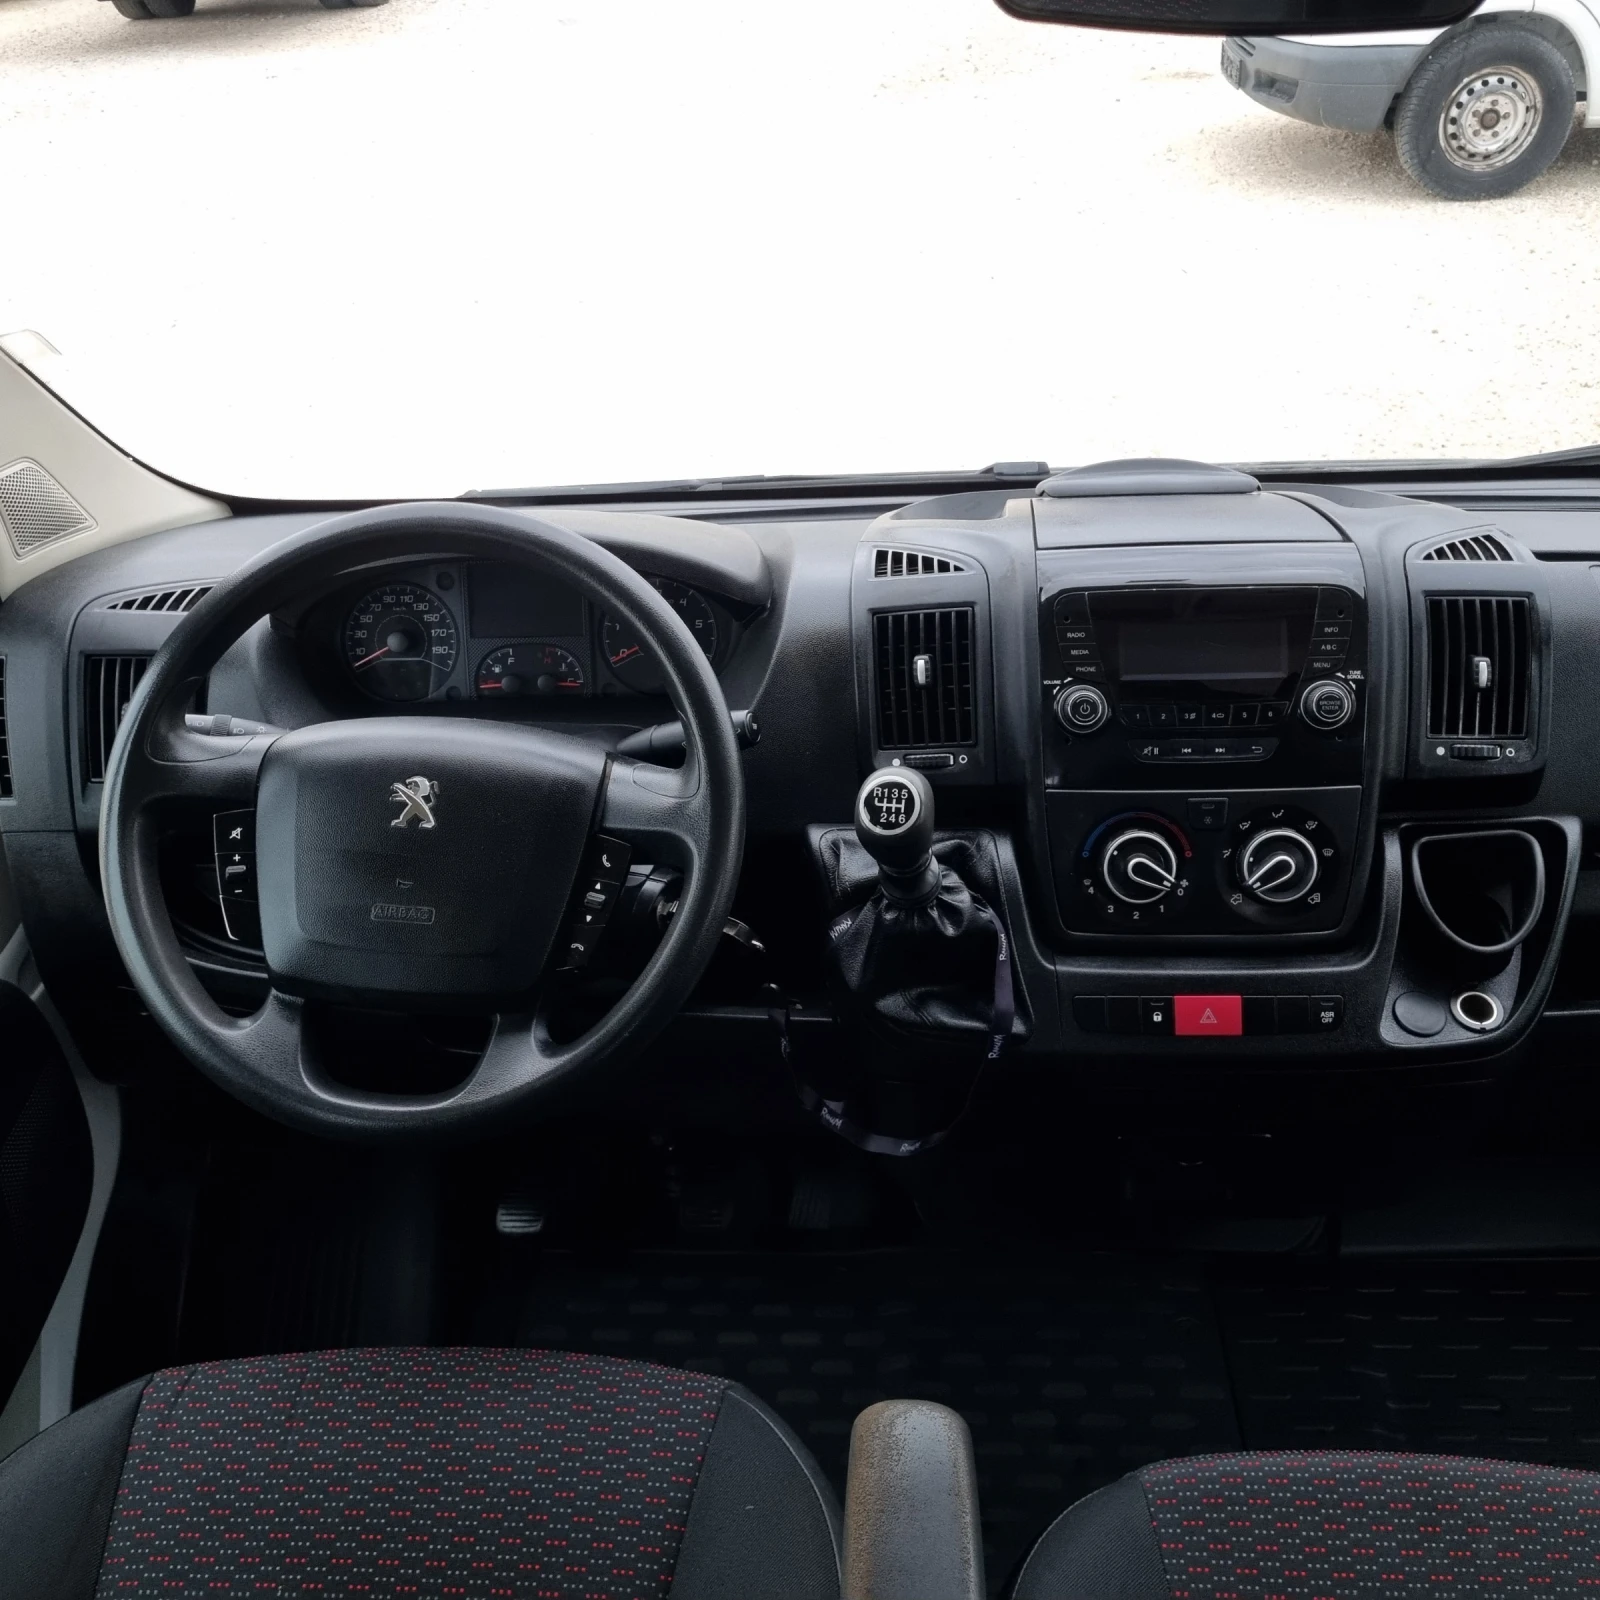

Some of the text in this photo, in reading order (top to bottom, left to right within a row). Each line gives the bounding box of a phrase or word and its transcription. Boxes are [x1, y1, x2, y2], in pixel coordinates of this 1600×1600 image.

[383, 595, 396, 603] 90
[400, 595, 414, 603] 110
[679, 598, 687, 606] 4
[369, 603, 382, 612] 70
[412, 603, 429, 611] 130
[423, 614, 440, 622] 150
[695, 619, 703, 628] 5
[354, 630, 368, 638] 30
[431, 629, 447, 637] 170
[355, 647, 366, 655] 10
[431, 646, 448, 654] 190
[507, 657, 515, 665] F
[873, 787, 908, 799] R 1 3 5
[880, 812, 906, 824] 2 4 6
[1087, 886, 1095, 895] 4
[1177, 888, 1184, 896] 0
[373, 905, 430, 920] AIRBAG
[1107, 905, 1114, 913] 3
[1159, 905, 1164, 913] 1
[1133, 911, 1140, 919] 2
